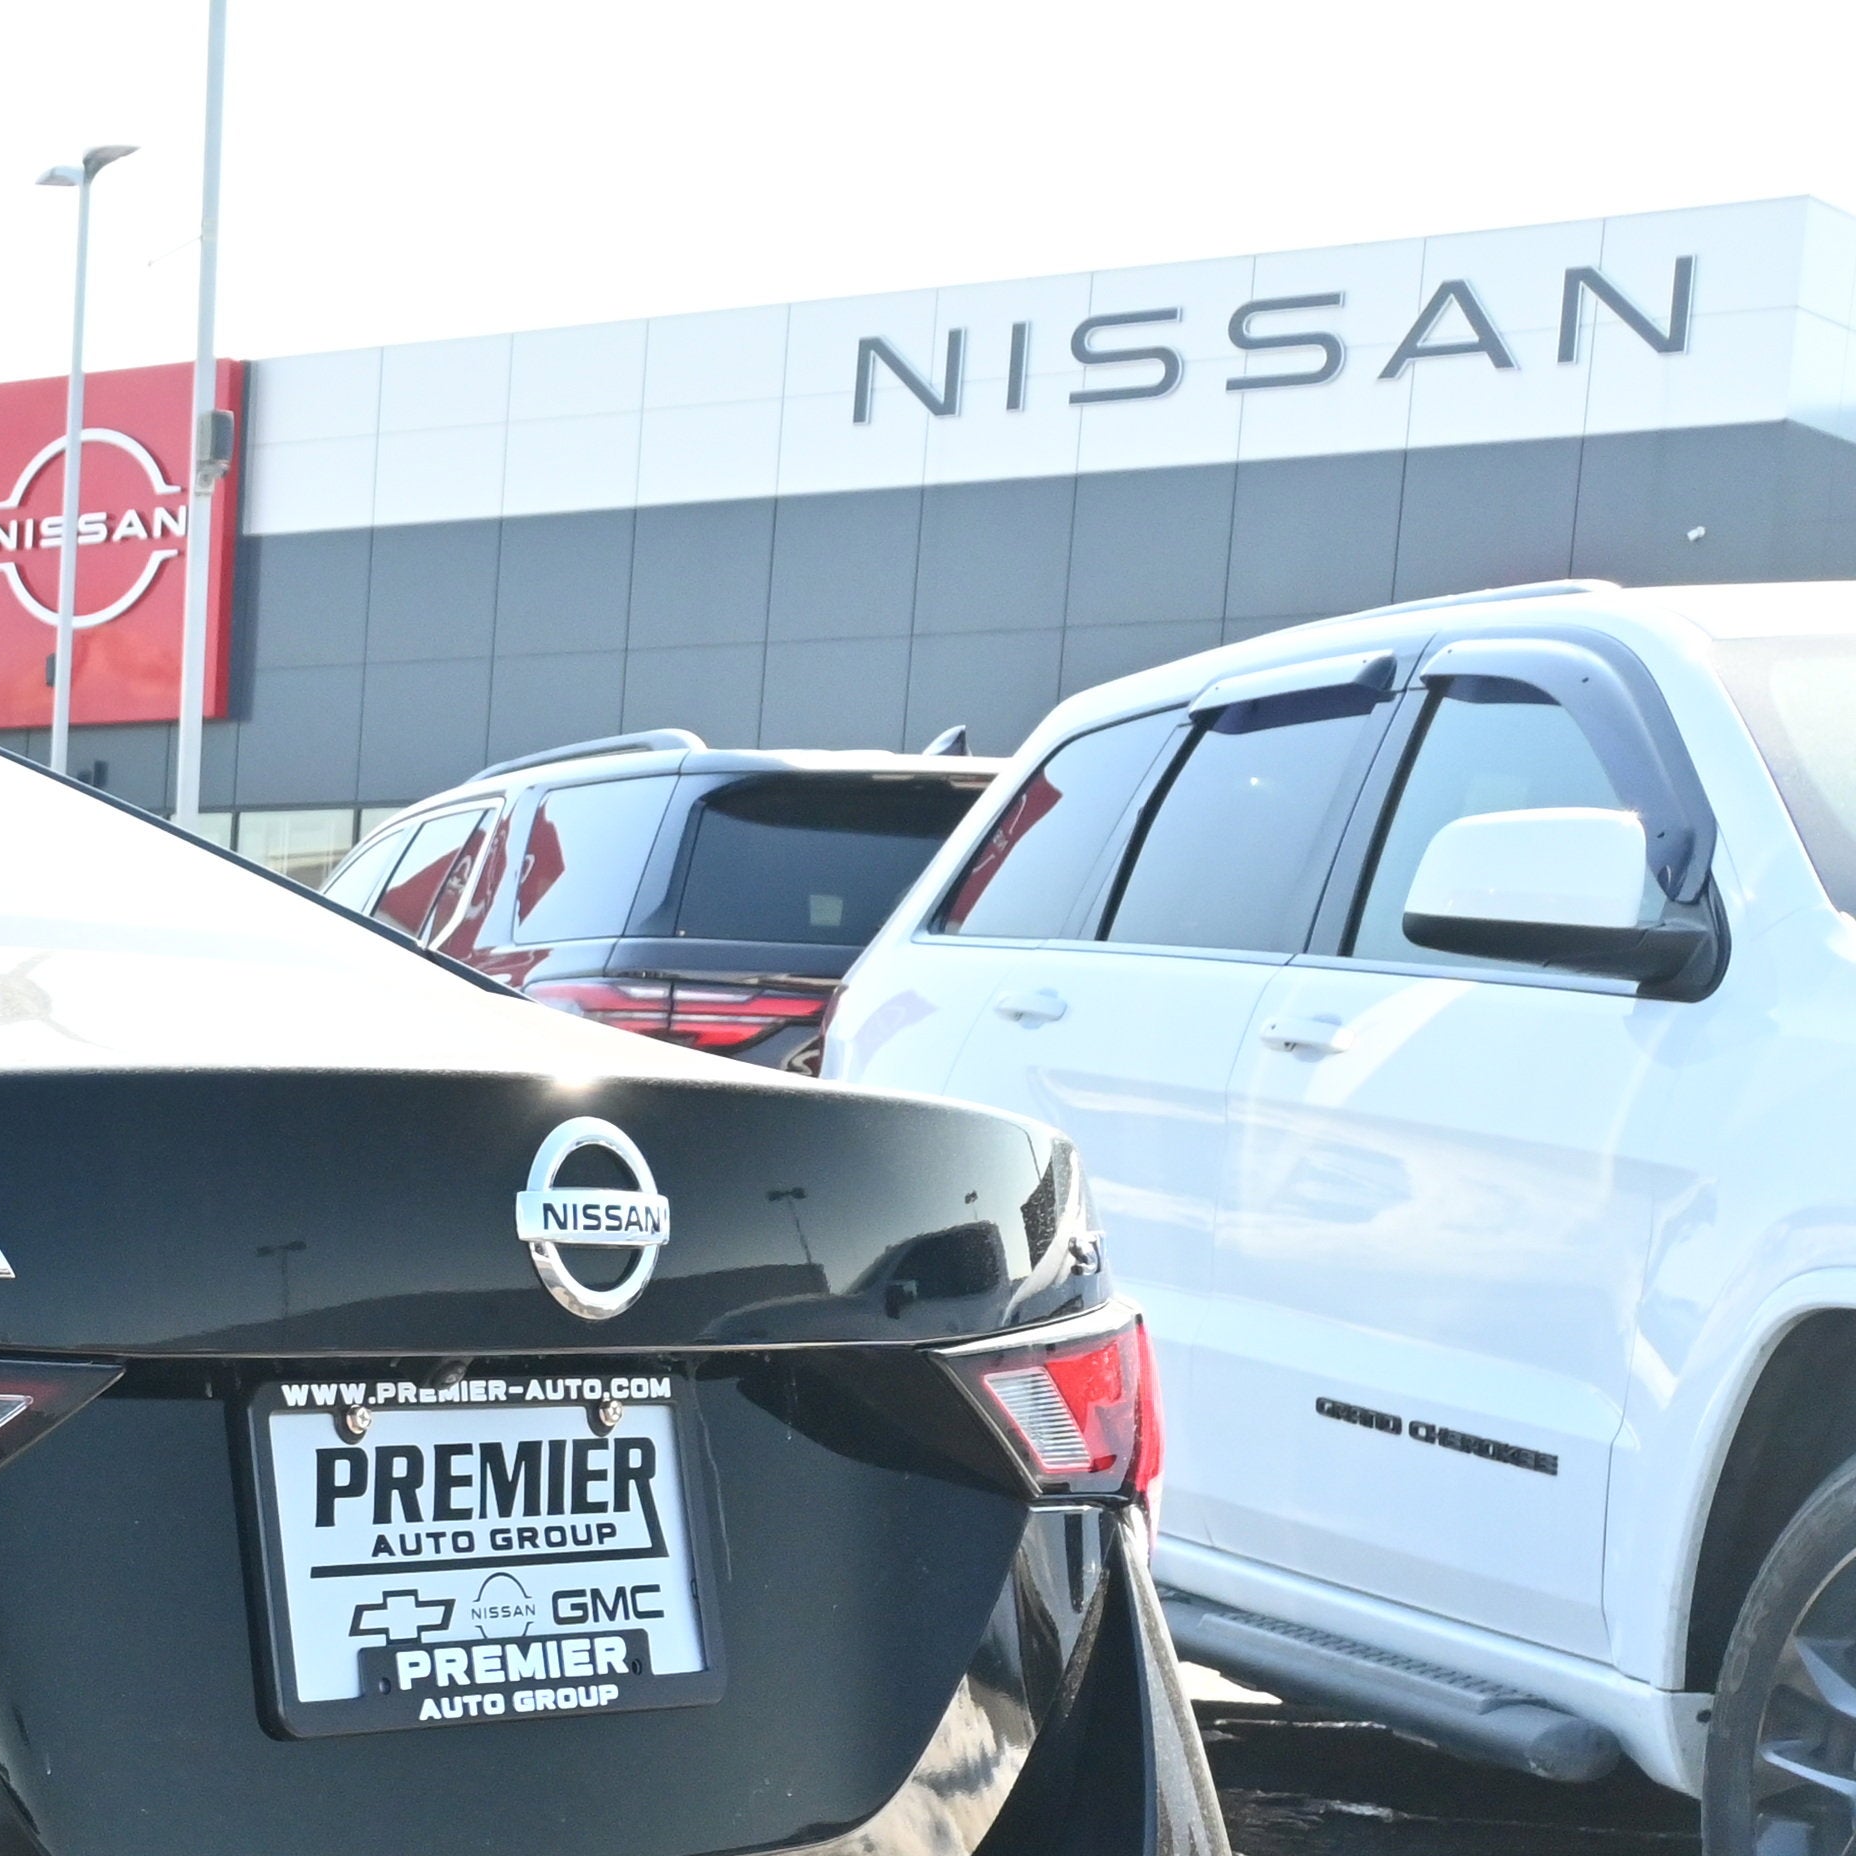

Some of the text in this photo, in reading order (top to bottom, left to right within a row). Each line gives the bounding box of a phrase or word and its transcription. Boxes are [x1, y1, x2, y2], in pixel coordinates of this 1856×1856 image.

[852, 253, 1697, 424] NISSAN
[542, 1202, 661, 1234] NISSAN
[281, 1377, 672, 1407] WWW.PREMIER-AUTO.COM
[315, 1437, 657, 1528] PREMIER
[371, 1522, 618, 1558] AUTO GROUP
[470, 1583, 665, 1626] NISSAN GMC
[395, 1636, 630, 1691] PREMIER
[419, 1684, 620, 1721] AUTO GROUP
